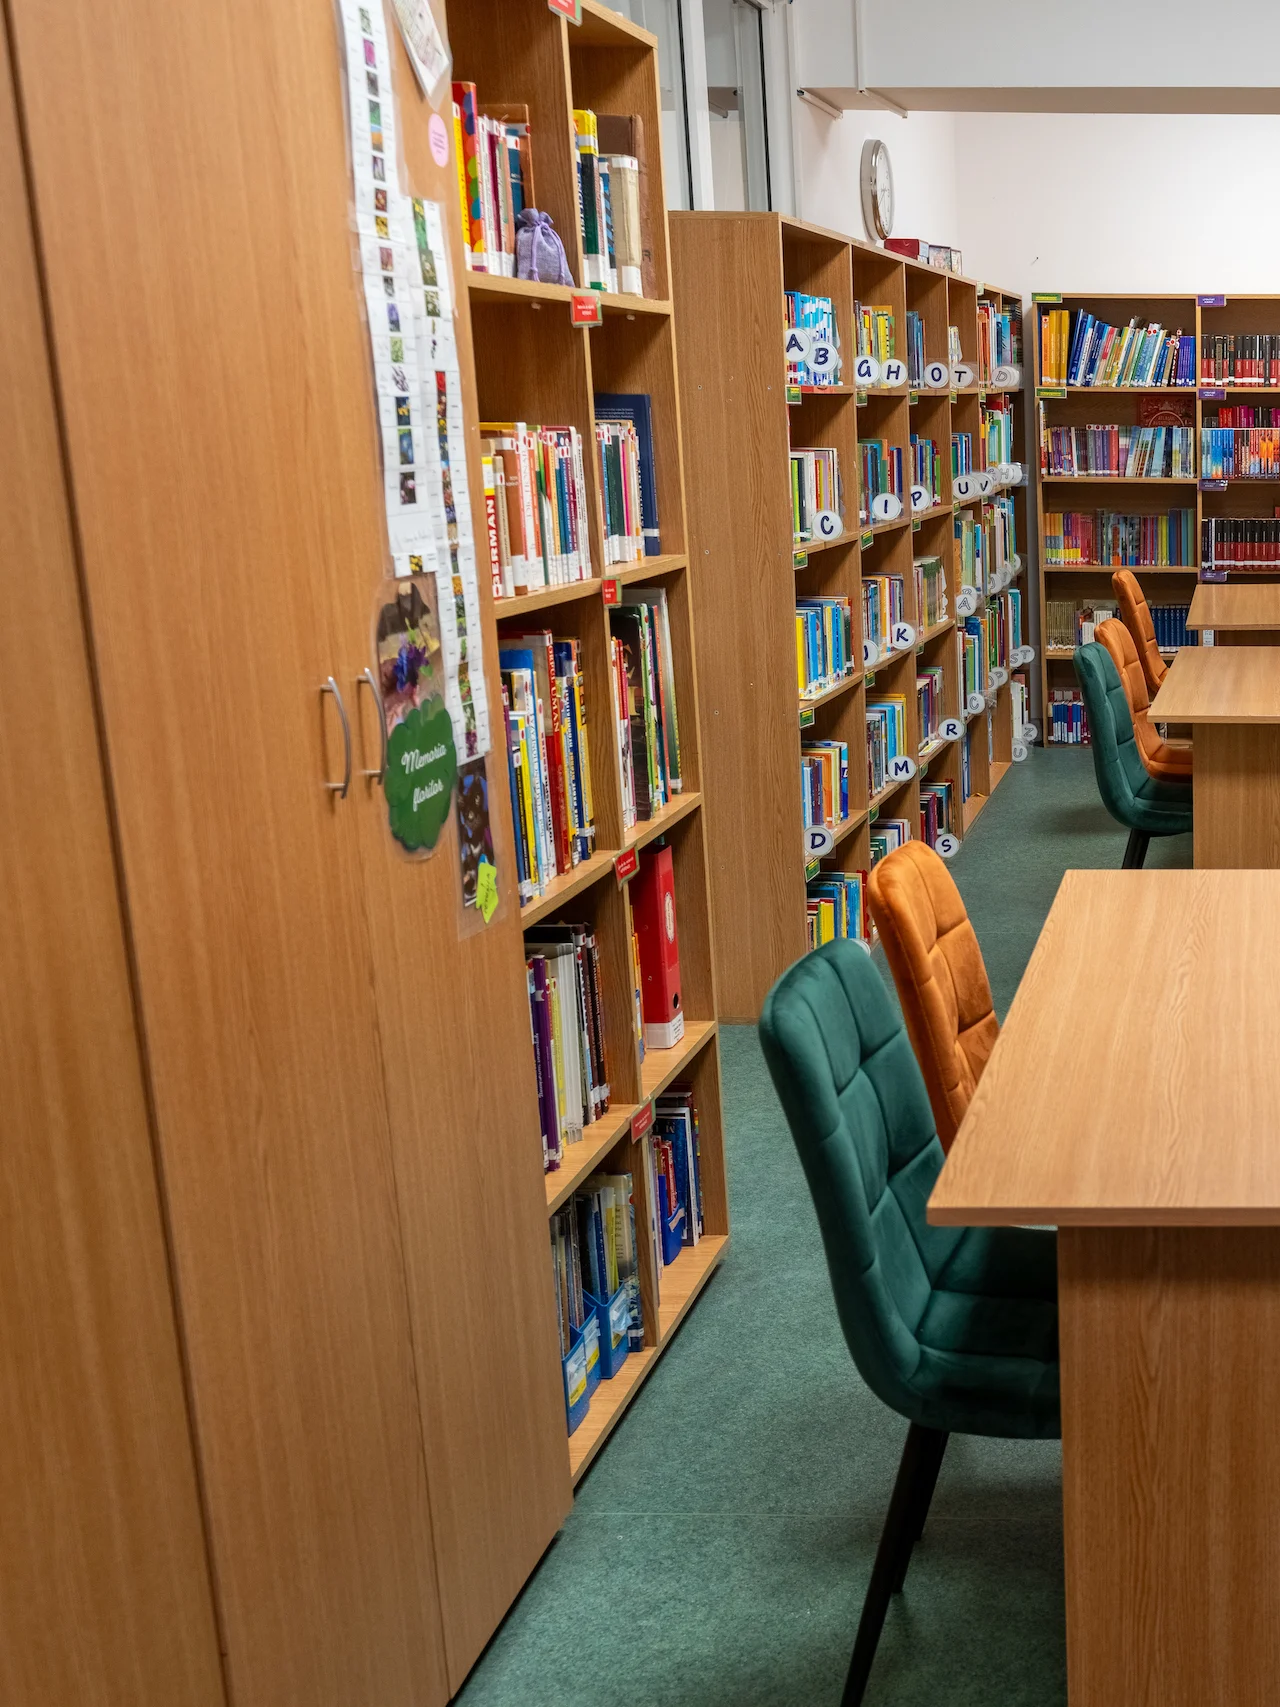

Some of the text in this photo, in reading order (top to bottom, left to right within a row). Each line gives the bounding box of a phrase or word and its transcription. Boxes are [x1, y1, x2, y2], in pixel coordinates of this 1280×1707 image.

[786, 333, 804, 353] A
[814, 347, 829, 365] B
[857, 359, 872, 378] G
[886, 364, 901, 380] H
[931, 367, 942, 382] O
[954, 370, 967, 383] T
[995, 370, 1008, 382] D
[958, 481, 969, 495] U
[980, 480, 989, 492] V
[910, 491, 922, 507] P
[883, 499, 889, 514] I
[820, 515, 834, 535] C
[957, 597, 971, 611] A
[895, 628, 909, 642] K
[1010, 653, 1019, 664] S
[1020, 650, 1031, 660] T
[550, 687, 560, 732] UMAN
[969, 696, 979, 710] C
[946, 723, 958, 736] R
[1023, 727, 1034, 738] Z
[401, 742, 447, 775] Memoria
[1013, 747, 1023, 758] U
[894, 760, 909, 776] M
[810, 833, 826, 849] D
[941, 839, 952, 853] S
